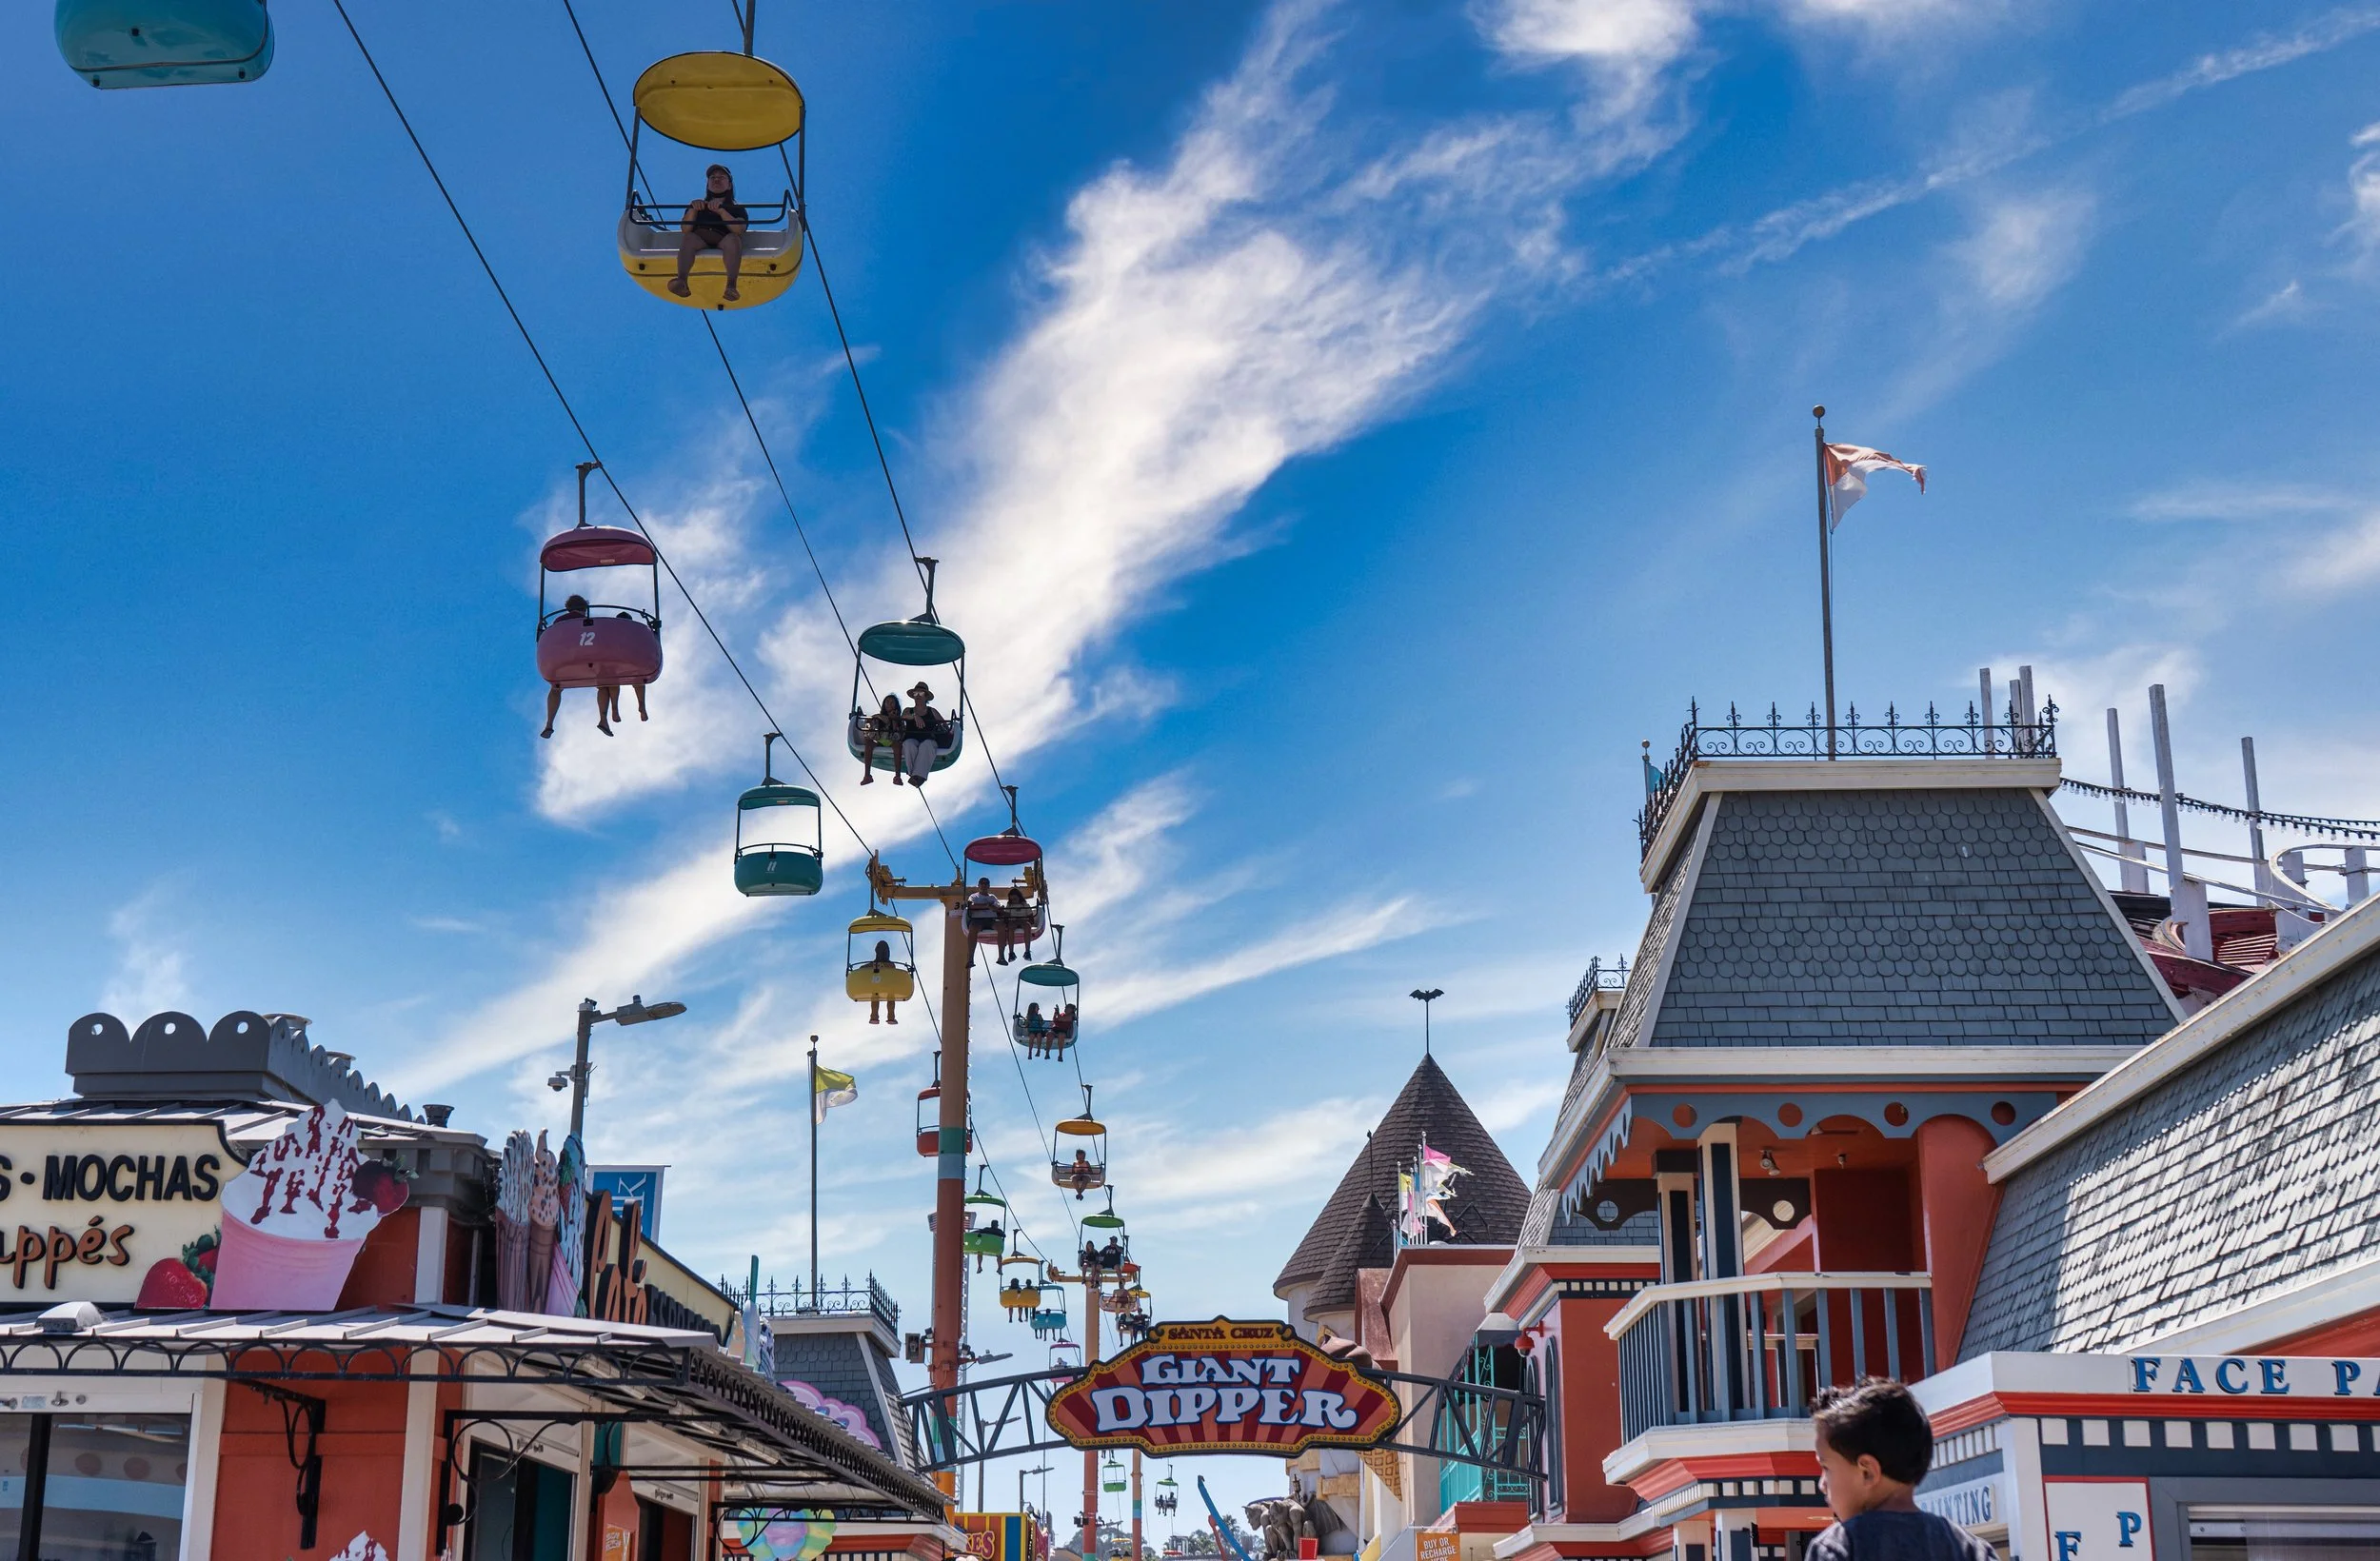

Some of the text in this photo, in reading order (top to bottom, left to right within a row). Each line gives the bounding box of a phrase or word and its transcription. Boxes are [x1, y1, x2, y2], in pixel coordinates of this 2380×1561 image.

[579, 631, 596, 646] 12
[42, 1154, 221, 1202] MOCHAS
[1168, 1326, 1275, 1340] SANTA CRUZ
[1142, 1354, 1300, 1387] GIANT
[2130, 1357, 2291, 1394] FACE
[1091, 1386, 1359, 1433] DIPPER
[1423, 1537, 1450, 1550] BUY OR
[2115, 1512, 2142, 1548] P
[1420, 1546, 1458, 1560] RECHARGE
[2053, 1531, 2082, 1561] F
